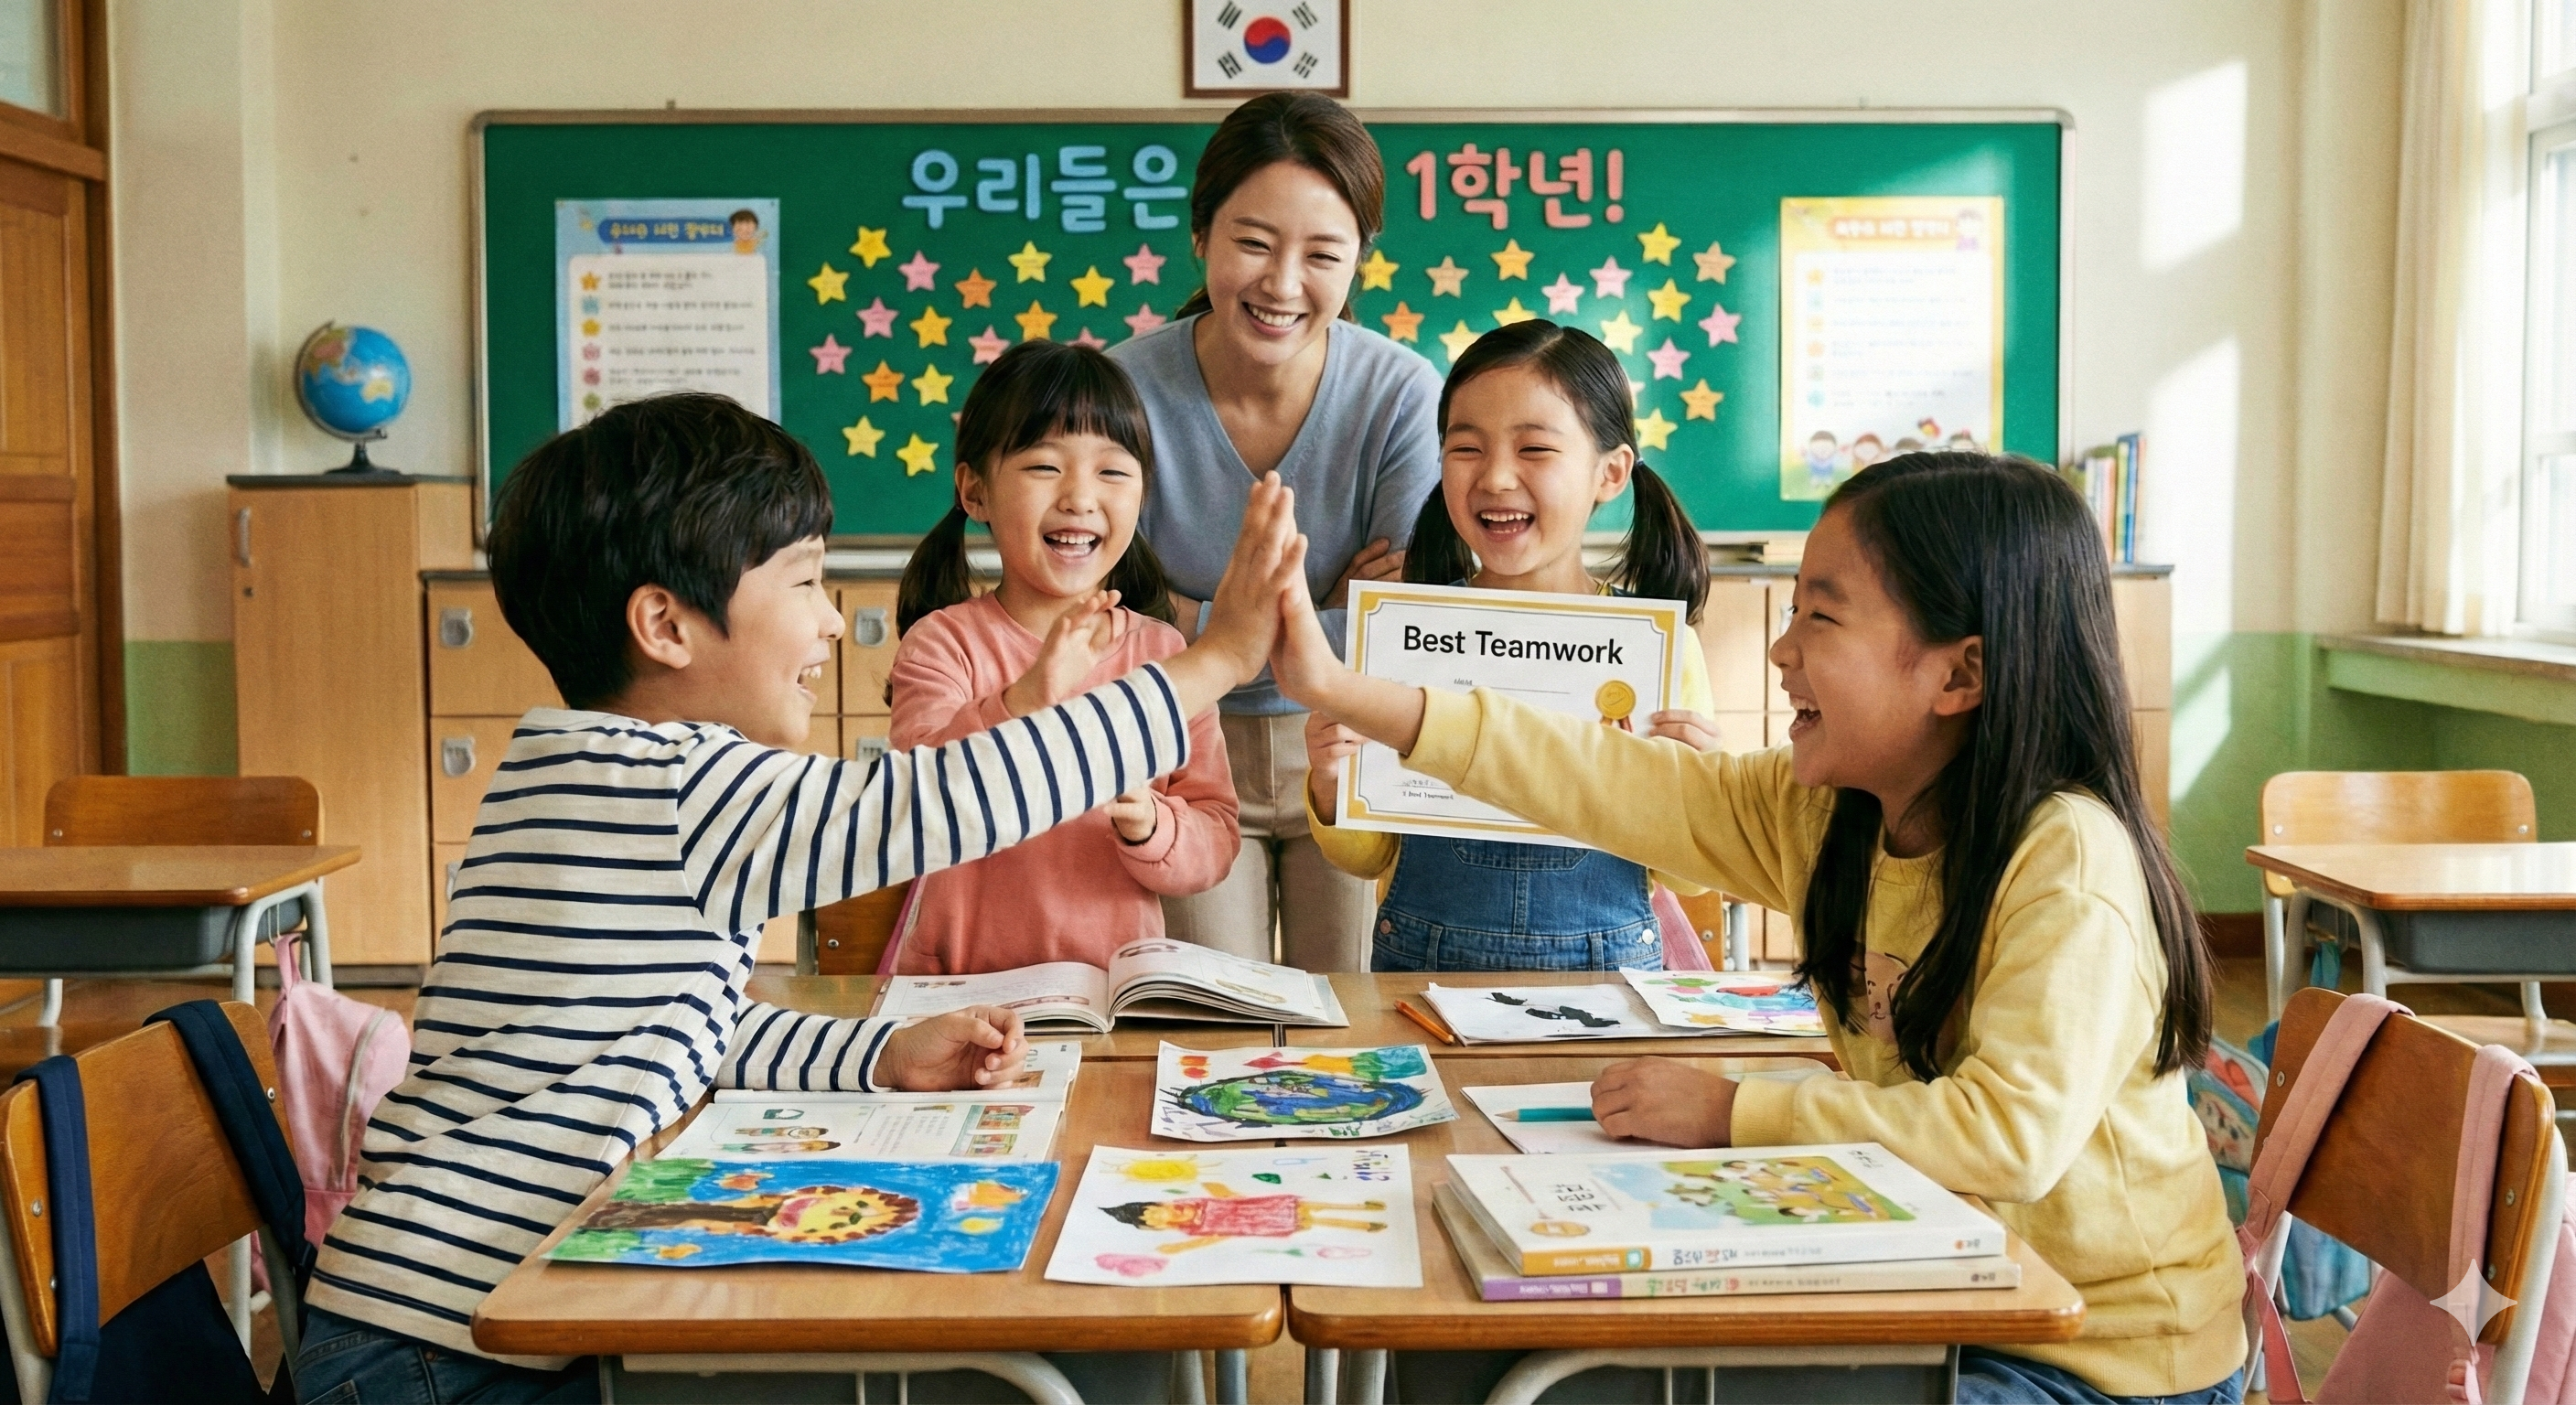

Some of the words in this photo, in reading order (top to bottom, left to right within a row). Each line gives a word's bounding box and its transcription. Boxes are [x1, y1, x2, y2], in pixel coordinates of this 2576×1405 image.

[902, 145, 1188, 233] 우리들은
[1406, 144, 1625, 230] 1학년!
[1403, 625, 1466, 654] Best
[1475, 630, 1624, 665] Teamwork
